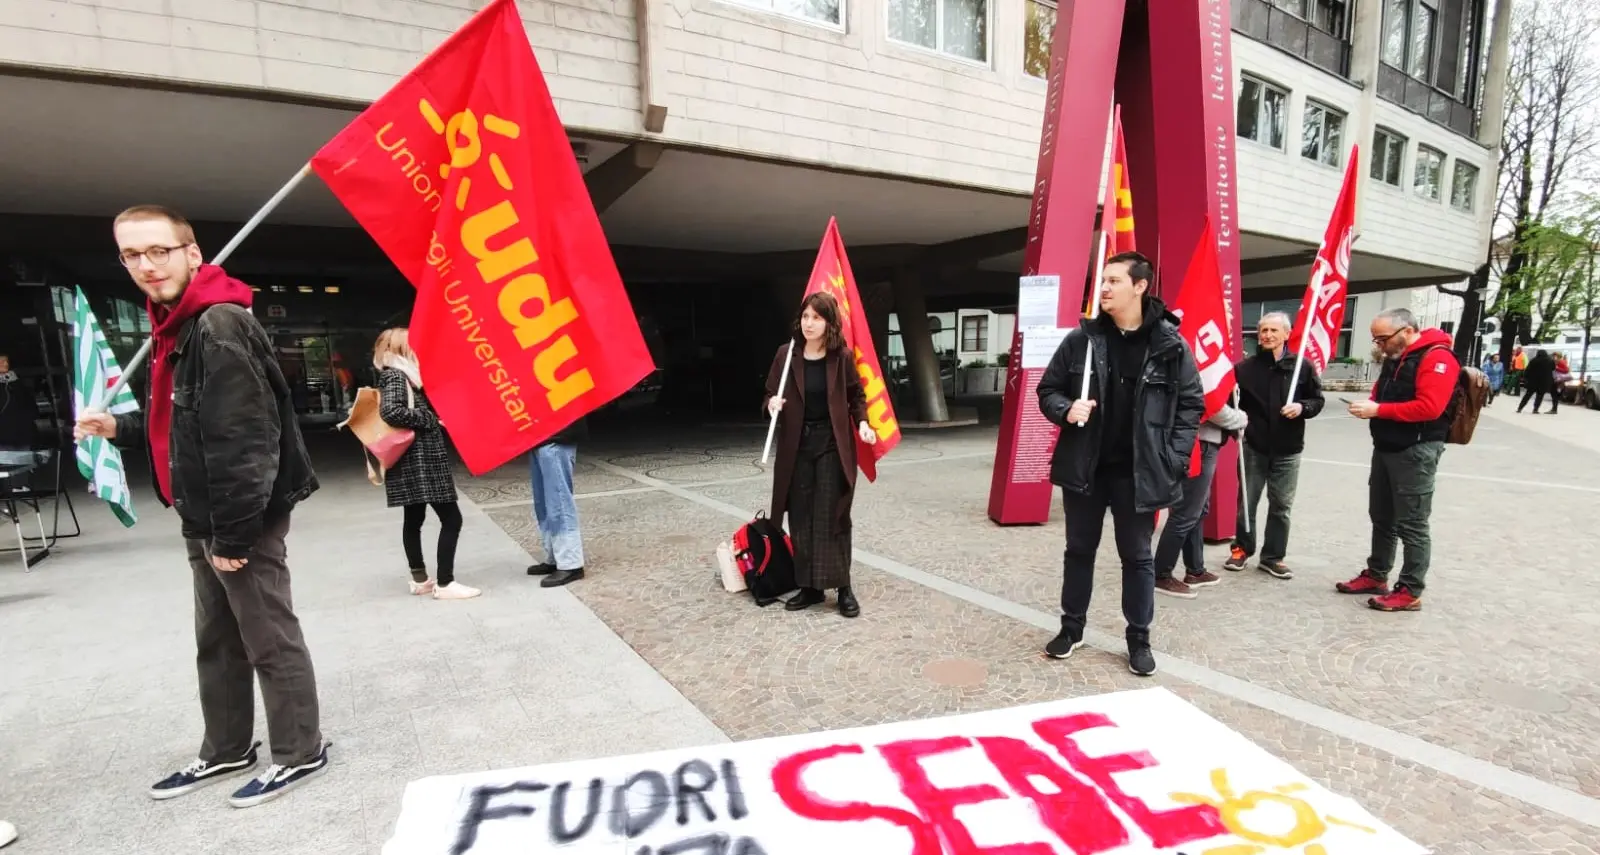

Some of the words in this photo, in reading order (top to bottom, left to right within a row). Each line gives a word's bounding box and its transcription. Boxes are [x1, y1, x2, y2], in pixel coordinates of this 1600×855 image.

[1216, 125, 1231, 252] Territorio
[443, 279, 540, 432] Universitari
[460, 200, 595, 411] udu
[448, 758, 749, 855] FUORI
